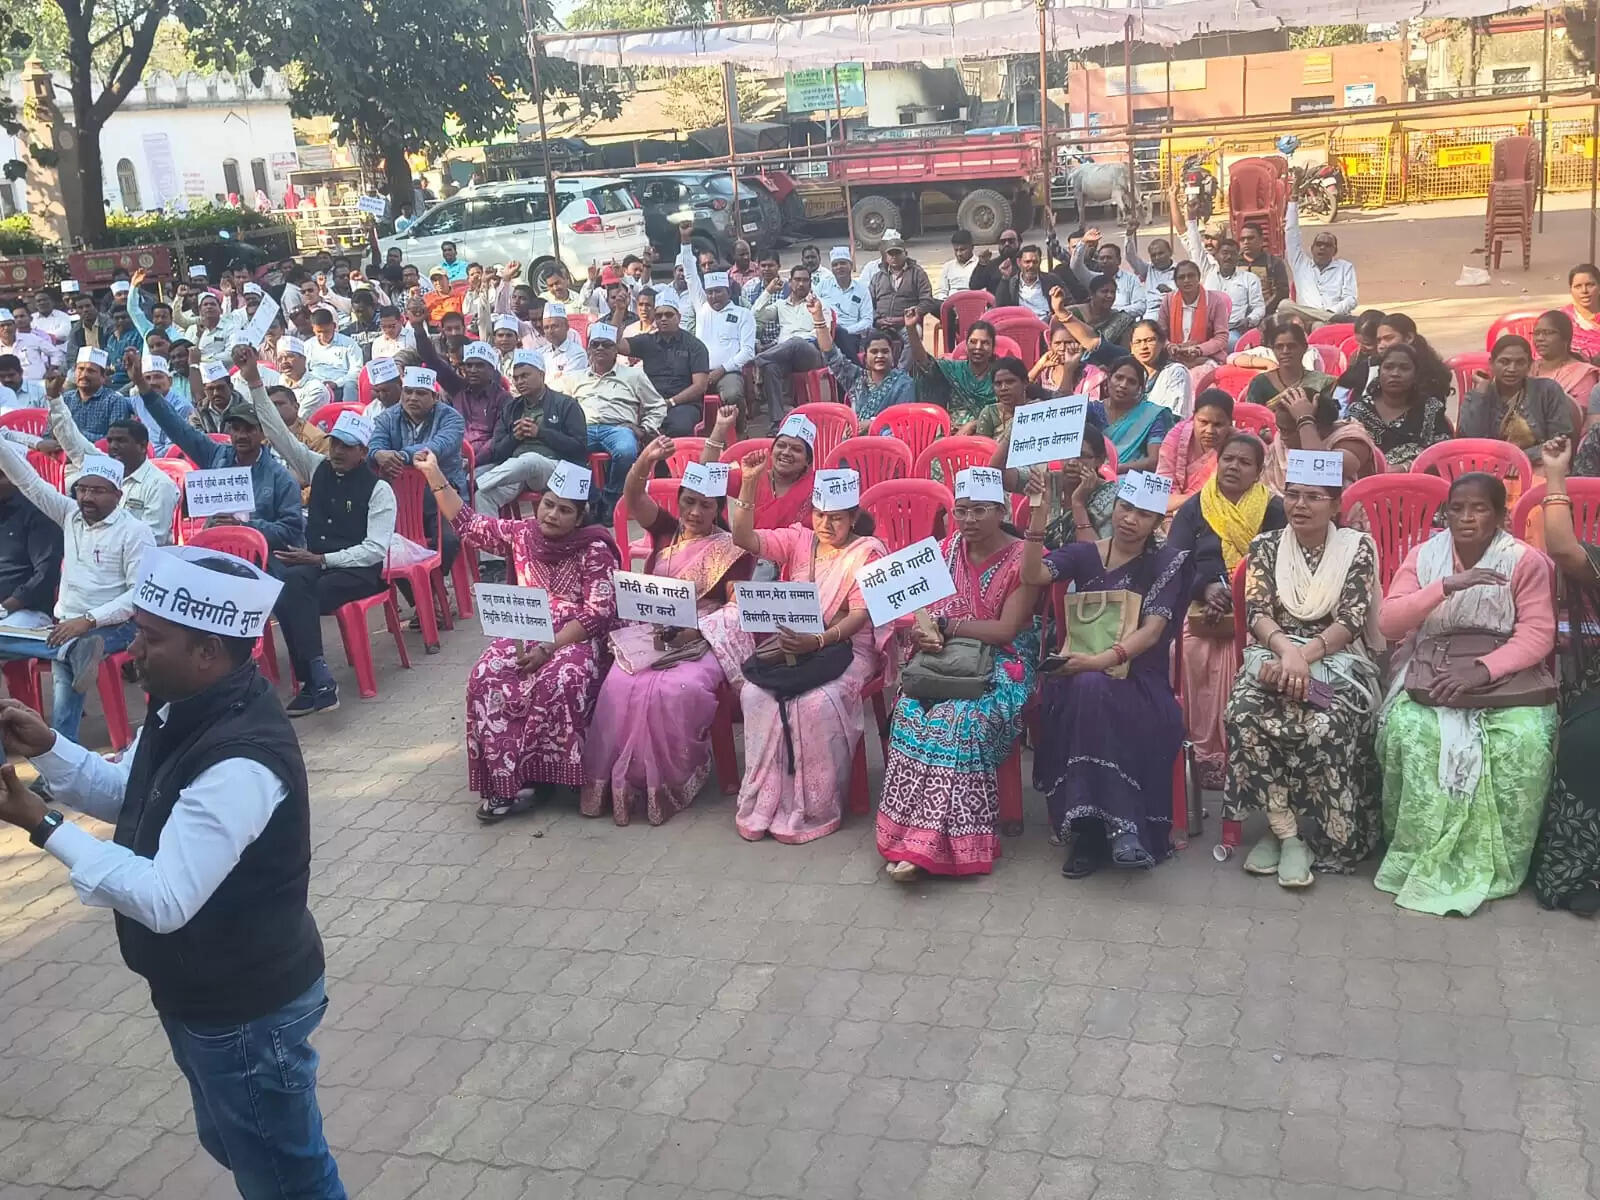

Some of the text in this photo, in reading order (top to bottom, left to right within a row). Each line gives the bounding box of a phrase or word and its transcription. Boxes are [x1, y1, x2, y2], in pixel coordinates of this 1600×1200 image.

[1017, 412, 1030, 425] मेरा
[1060, 404, 1083, 417] सम्मान
[1012, 432, 1080, 453] विसंगति मुक्त वेतनमान
[972, 469, 991, 487] नियुक्ति
[1144, 474, 1162, 495] नियुक्ति
[862, 547, 936, 589] मोदी की गारंटी
[619, 579, 690, 600] मोदी की गारंटी
[740, 587, 754, 600] मेरा
[789, 589, 815, 600] सम्मान
[887, 576, 930, 610] पूरा करो
[139, 573, 263, 636] वेतन विसंगति मुक्त
[636, 602, 676, 616] पूरा करो
[525, 613, 547, 627] वेतनमान
[743, 610, 818, 625] विसंगति मुक्त वेतनमान
